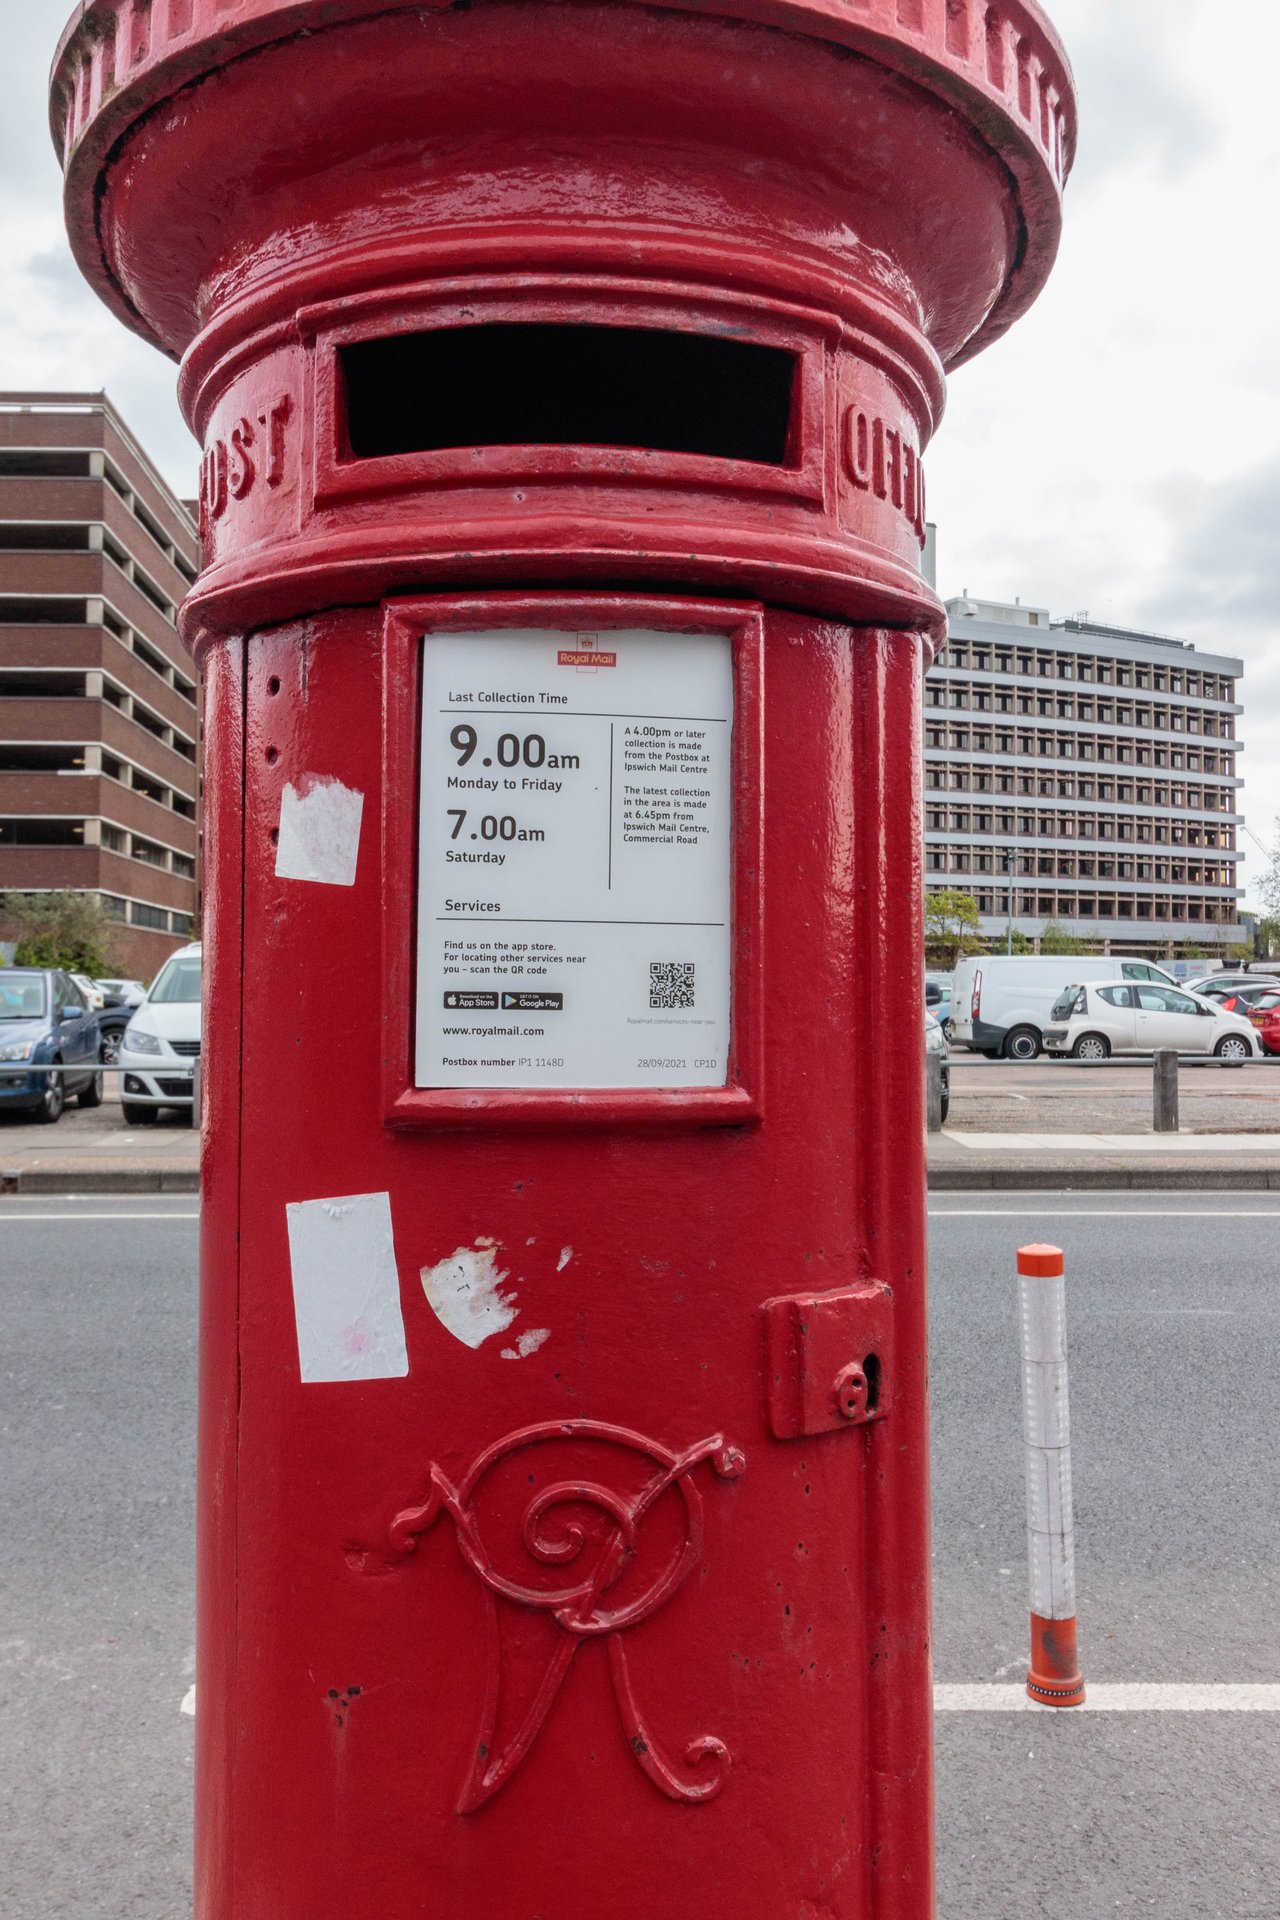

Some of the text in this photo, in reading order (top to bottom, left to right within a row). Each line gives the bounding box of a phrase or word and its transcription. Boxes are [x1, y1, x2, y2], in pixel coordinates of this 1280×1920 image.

[560, 652, 614, 665] Royal Mail
[449, 692, 567, 704] Last Collection Time
[634, 726, 670, 738] 4.00pm
[686, 730, 706, 738] later
[450, 724, 579, 769] 9.00am
[625, 740, 665, 748] collection
[679, 742, 701, 750] made
[625, 751, 645, 759] from
[648, 752, 662, 760] the
[666, 752, 698, 761] Postbox
[625, 763, 707, 773] Ipswich Mail Centre
[448, 777, 562, 793] Monday to Friday
[624, 786, 710, 796] The latest collection
[636, 810, 670, 821] 6.45pm
[674, 812, 693, 820] from
[447, 809, 544, 841] 7.00am
[624, 822, 655, 831] Ipswich
[659, 823, 676, 831] Mail
[624, 834, 697, 844] Commercial Road
[446, 851, 505, 865] Saturday
[445, 899, 500, 911] Services
[445, 941, 463, 949] Find
[494, 942, 508, 950] the
[444, 953, 458, 961] For
[462, 953, 497, 963] locating
[501, 954, 524, 962] other
[527, 954, 563, 962] services
[511, 966, 523, 974] QR
[527, 966, 547, 974] code
[458, 998, 496, 1008] App Store
[519, 999, 560, 1009] Google Play
[443, 1026, 544, 1037] www.royalmail.com
[481, 1058, 515, 1066] number
[637, 1058, 717, 1068] 28/09/2021 CP1D
